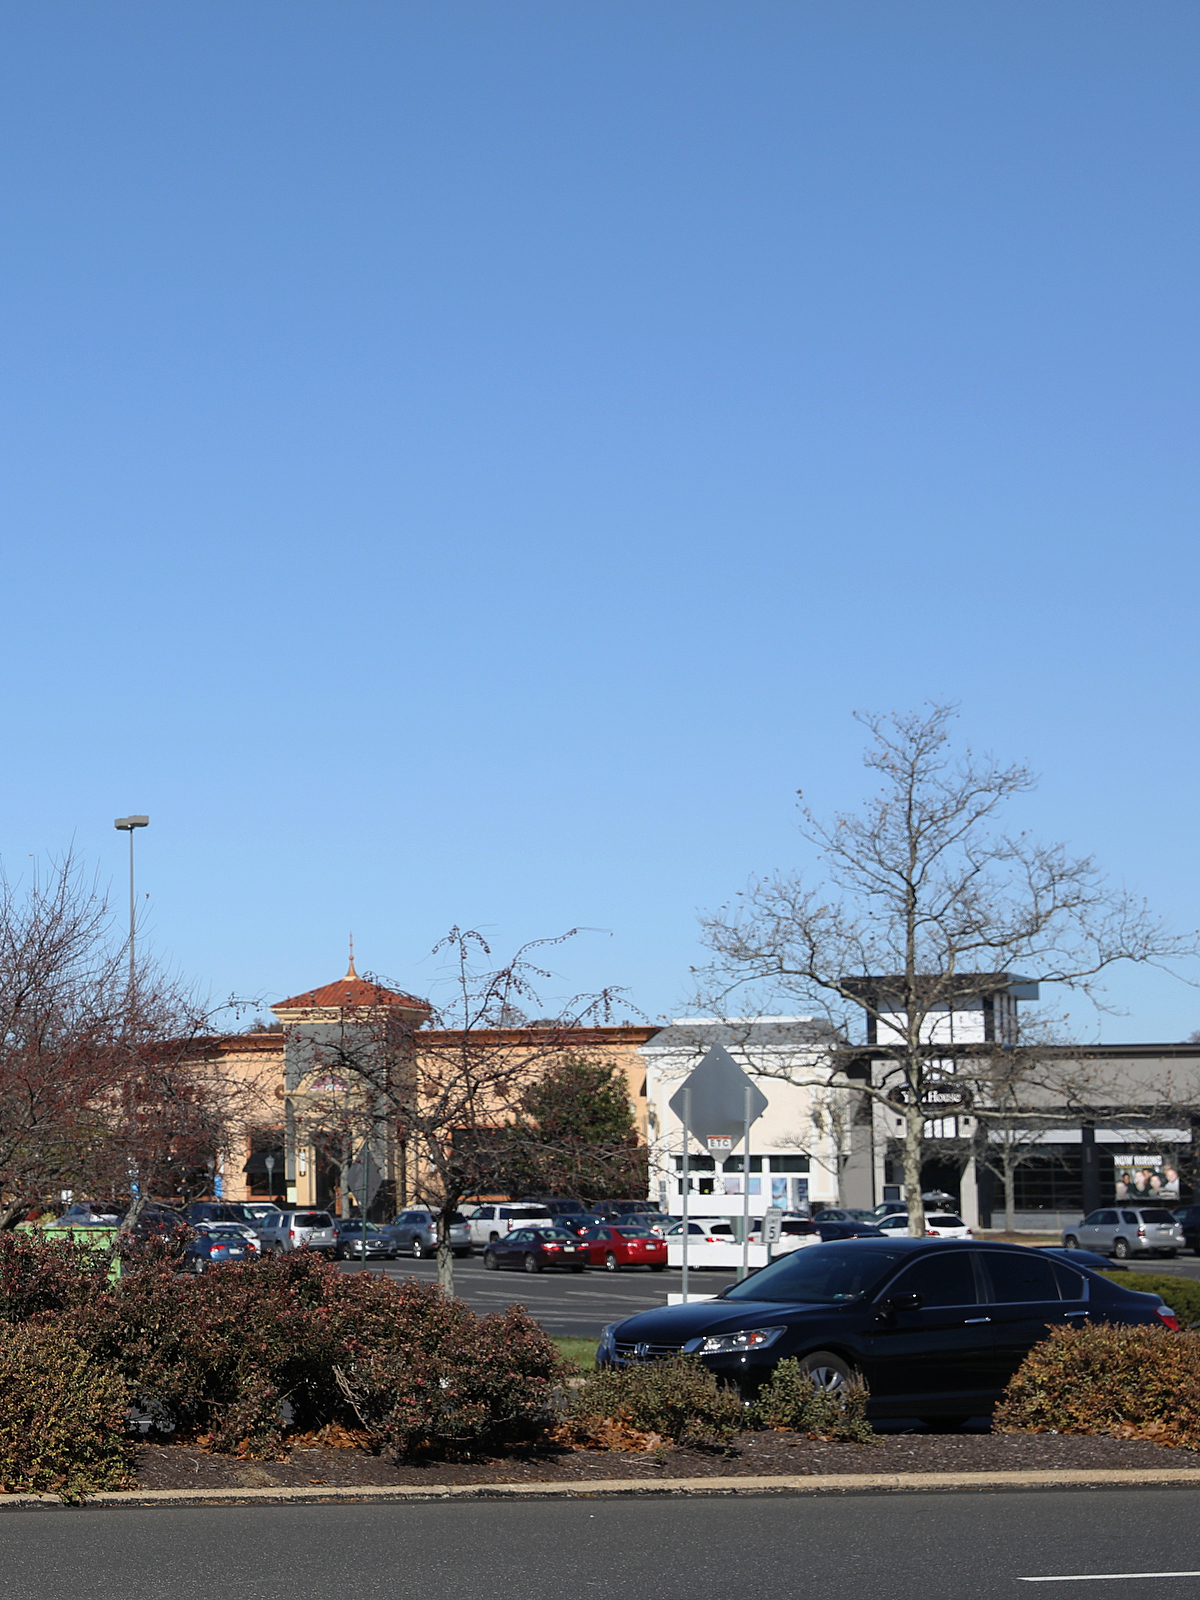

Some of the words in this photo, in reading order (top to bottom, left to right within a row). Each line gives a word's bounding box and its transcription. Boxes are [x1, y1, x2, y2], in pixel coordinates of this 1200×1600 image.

[927, 1090, 962, 1104] House
[710, 1139, 730, 1148] ETC
[769, 1226, 777, 1240] 5
